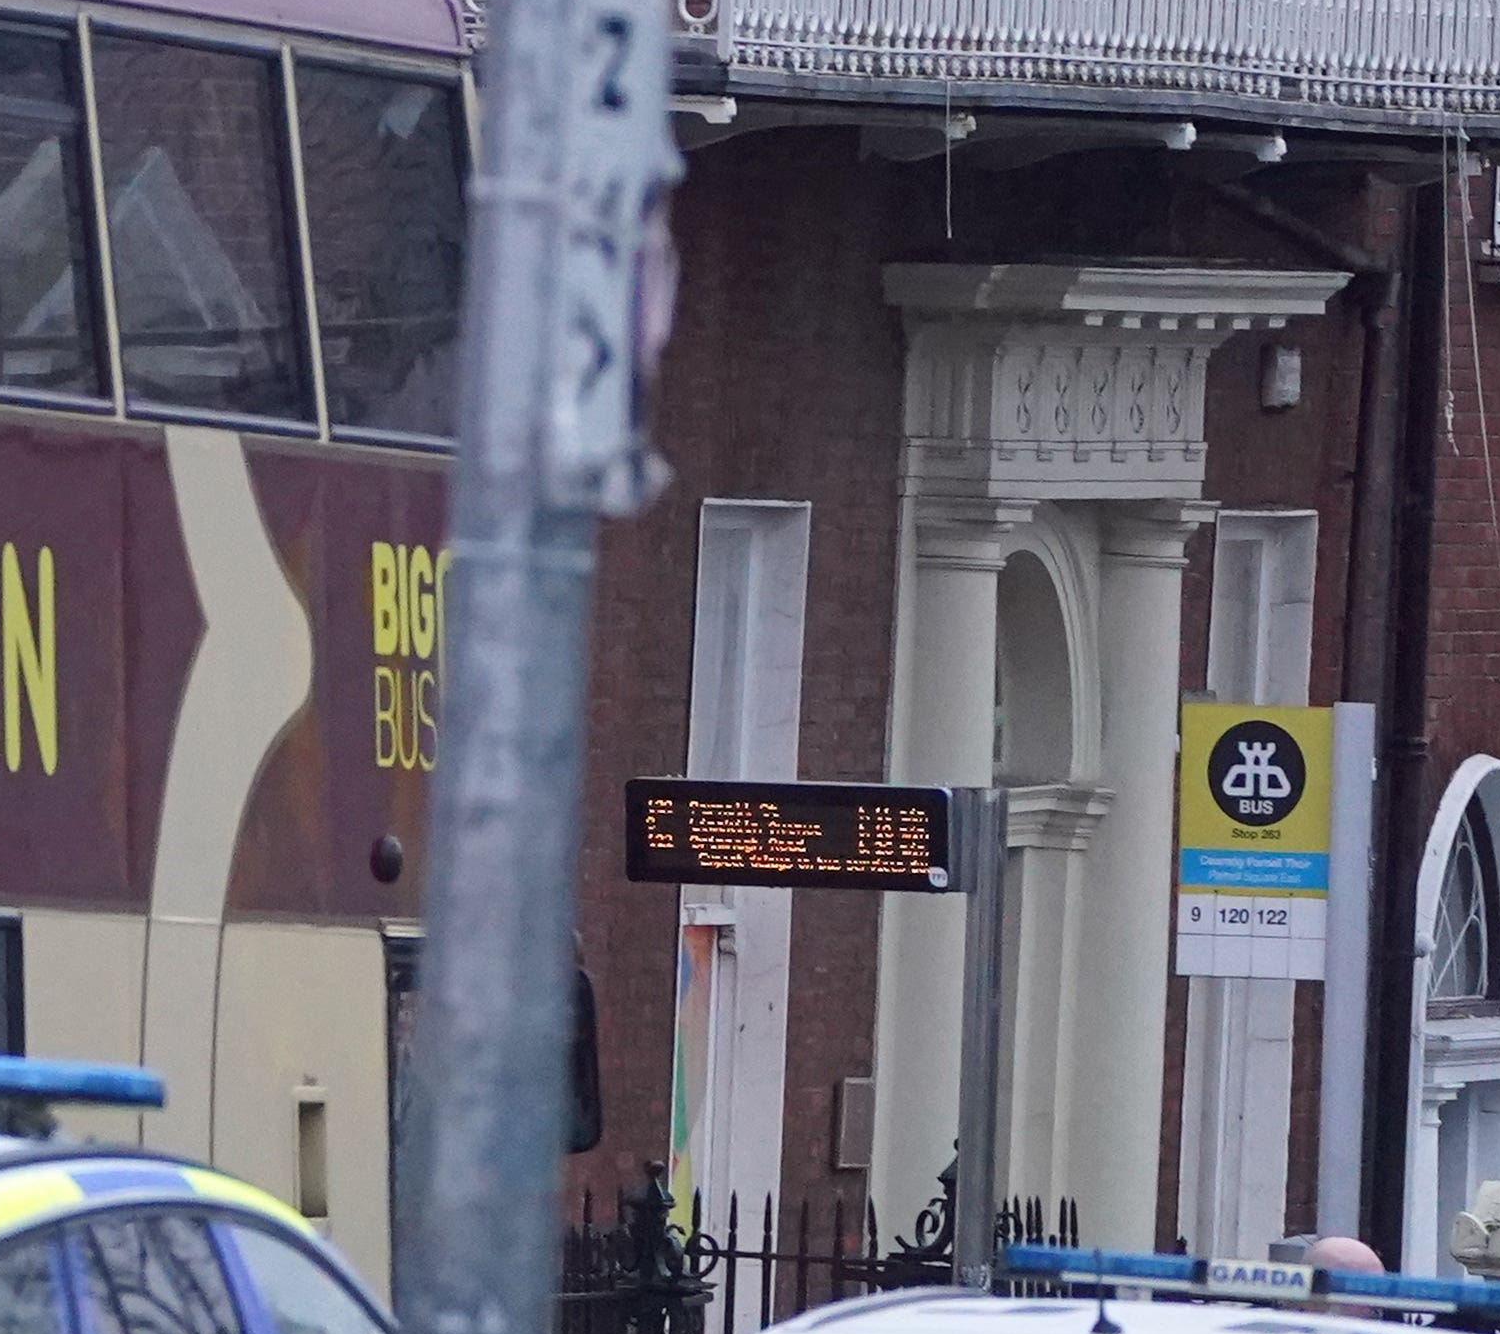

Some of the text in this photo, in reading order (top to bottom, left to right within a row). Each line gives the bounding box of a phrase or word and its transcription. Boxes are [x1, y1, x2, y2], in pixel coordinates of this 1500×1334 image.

[371, 541, 436, 660] BIG
[373, 665, 438, 772] BUS
[1239, 799, 1274, 815] BUS
[1231, 827, 1259, 841] Stop
[1191, 906, 1288, 926] 9 120 122
[1212, 1263, 1306, 1289] GARDA
